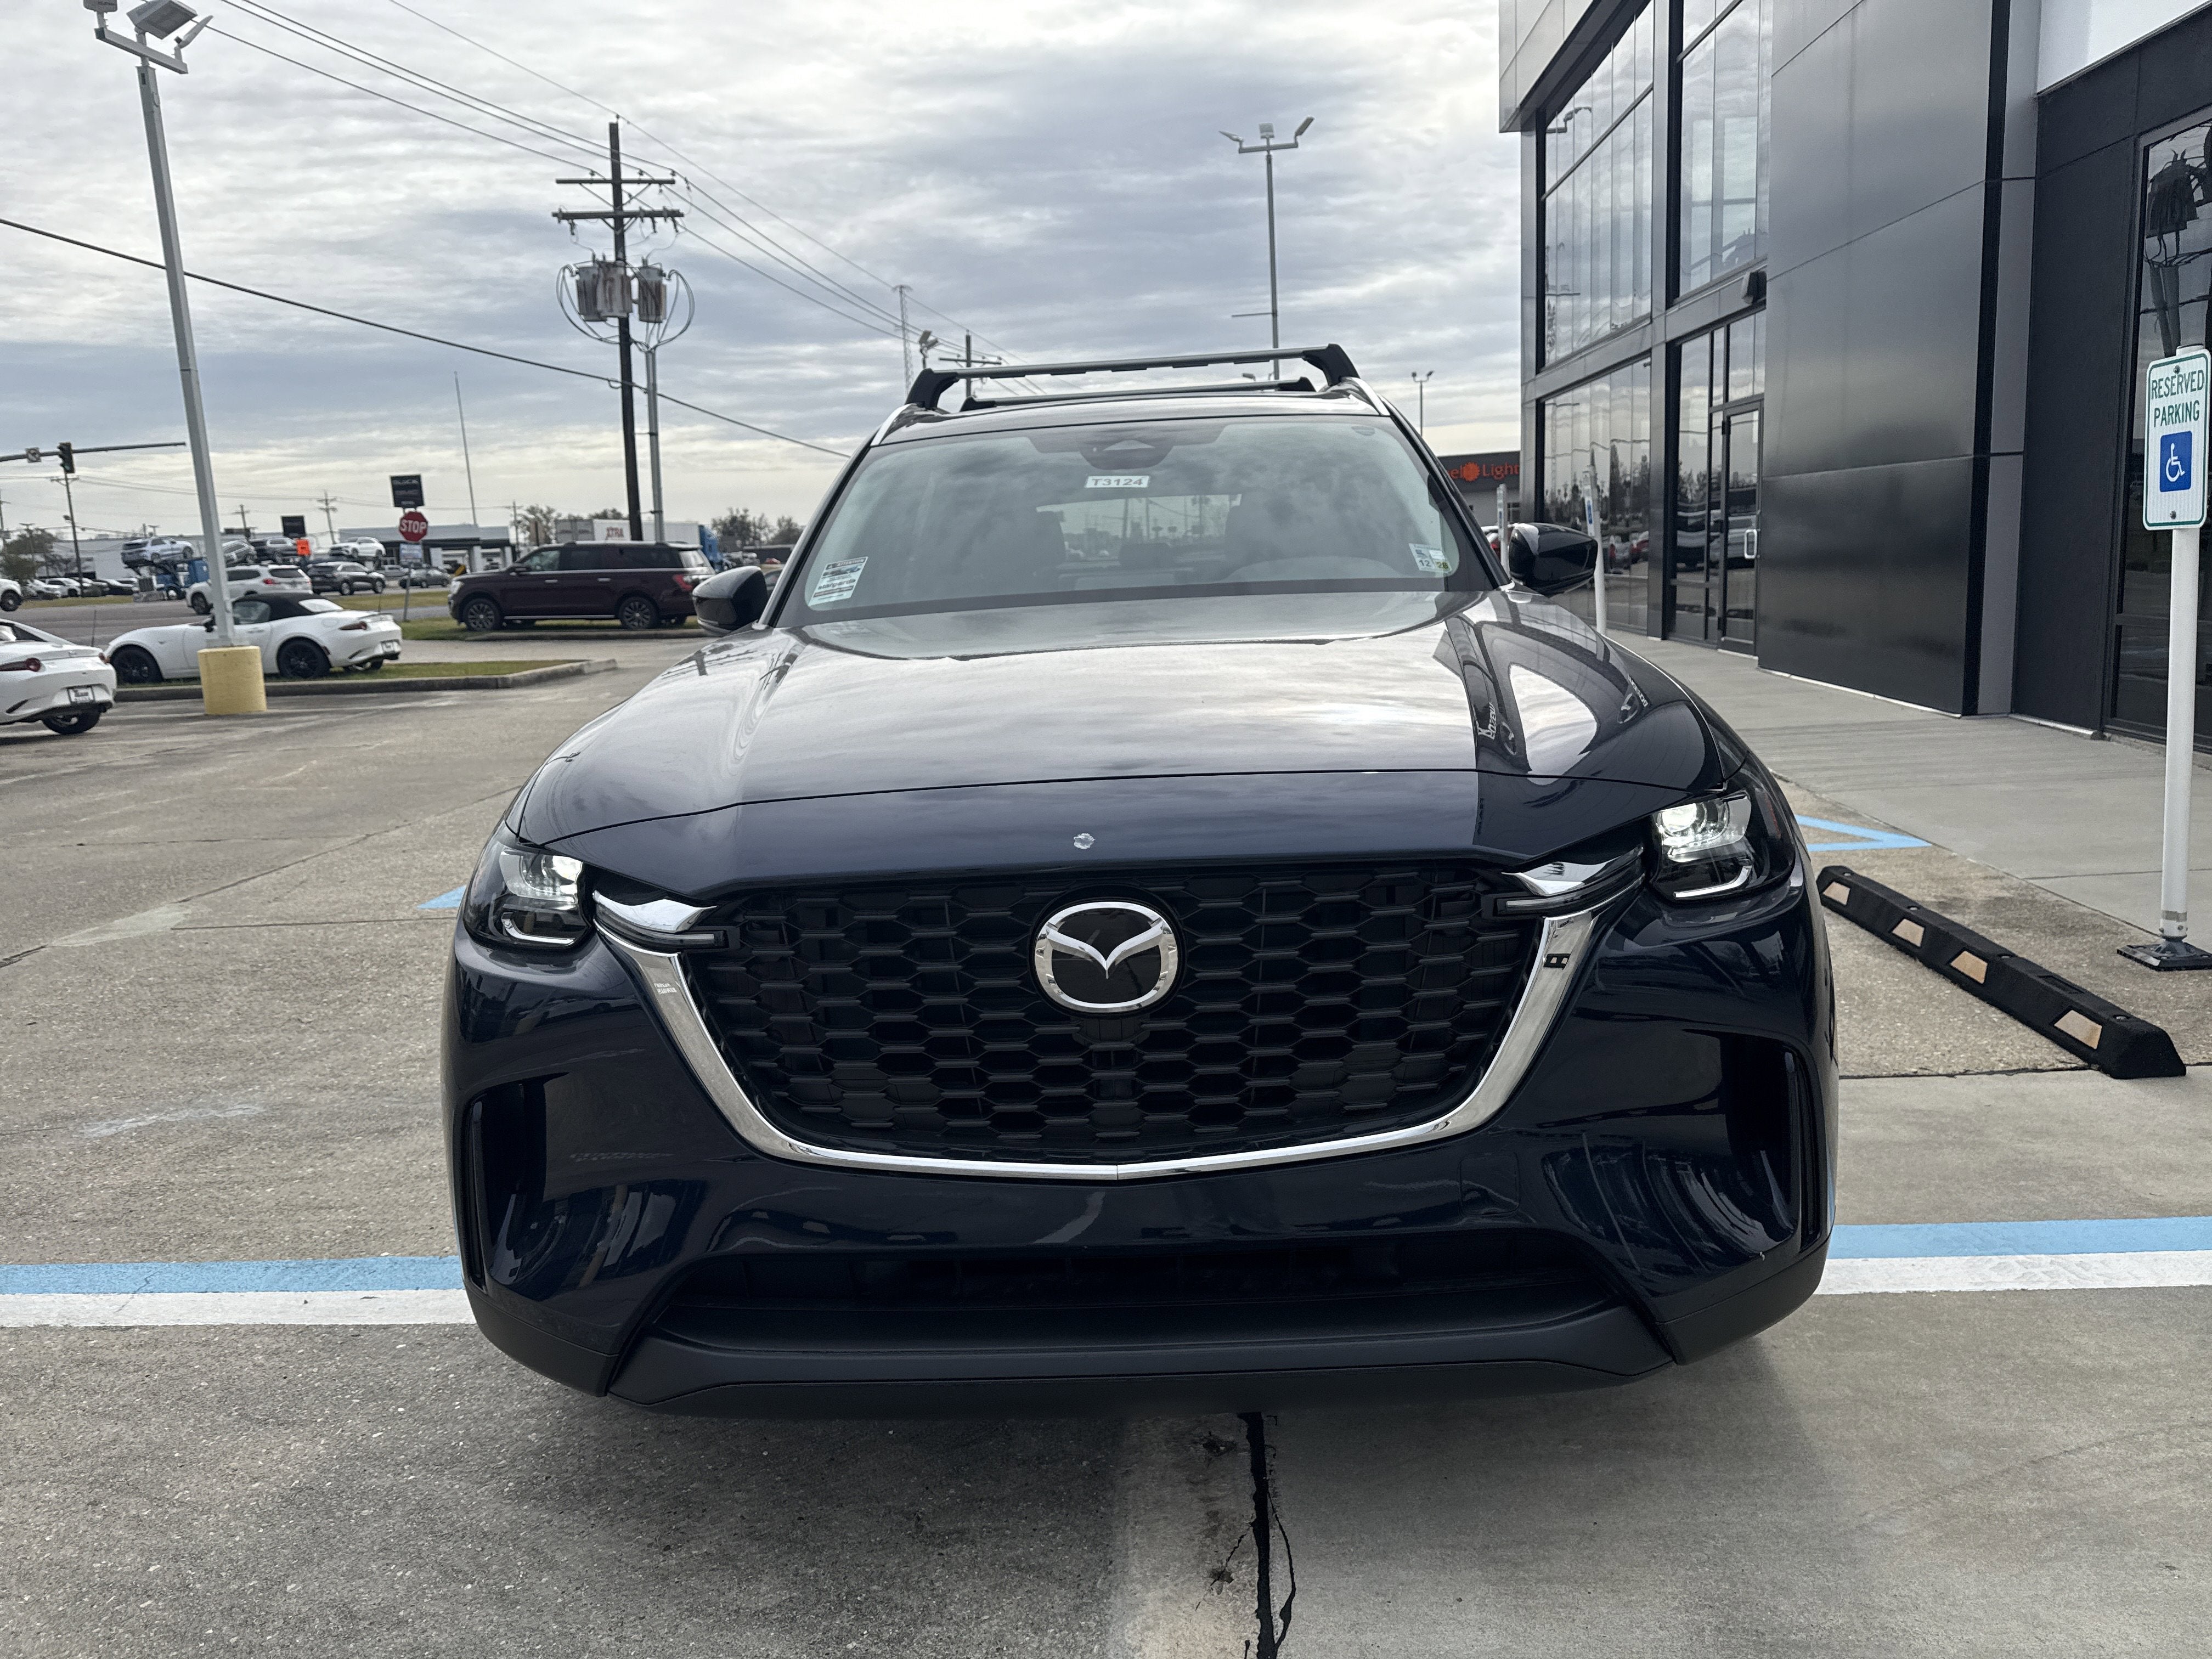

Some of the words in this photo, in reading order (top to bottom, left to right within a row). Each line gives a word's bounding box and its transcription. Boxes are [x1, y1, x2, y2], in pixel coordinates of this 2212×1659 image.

[2151, 369, 2204, 400] RESERVED
[2153, 400, 2200, 428] PARKING
[1092, 478, 1143, 486] T3124
[400, 519, 427, 534] STOP
